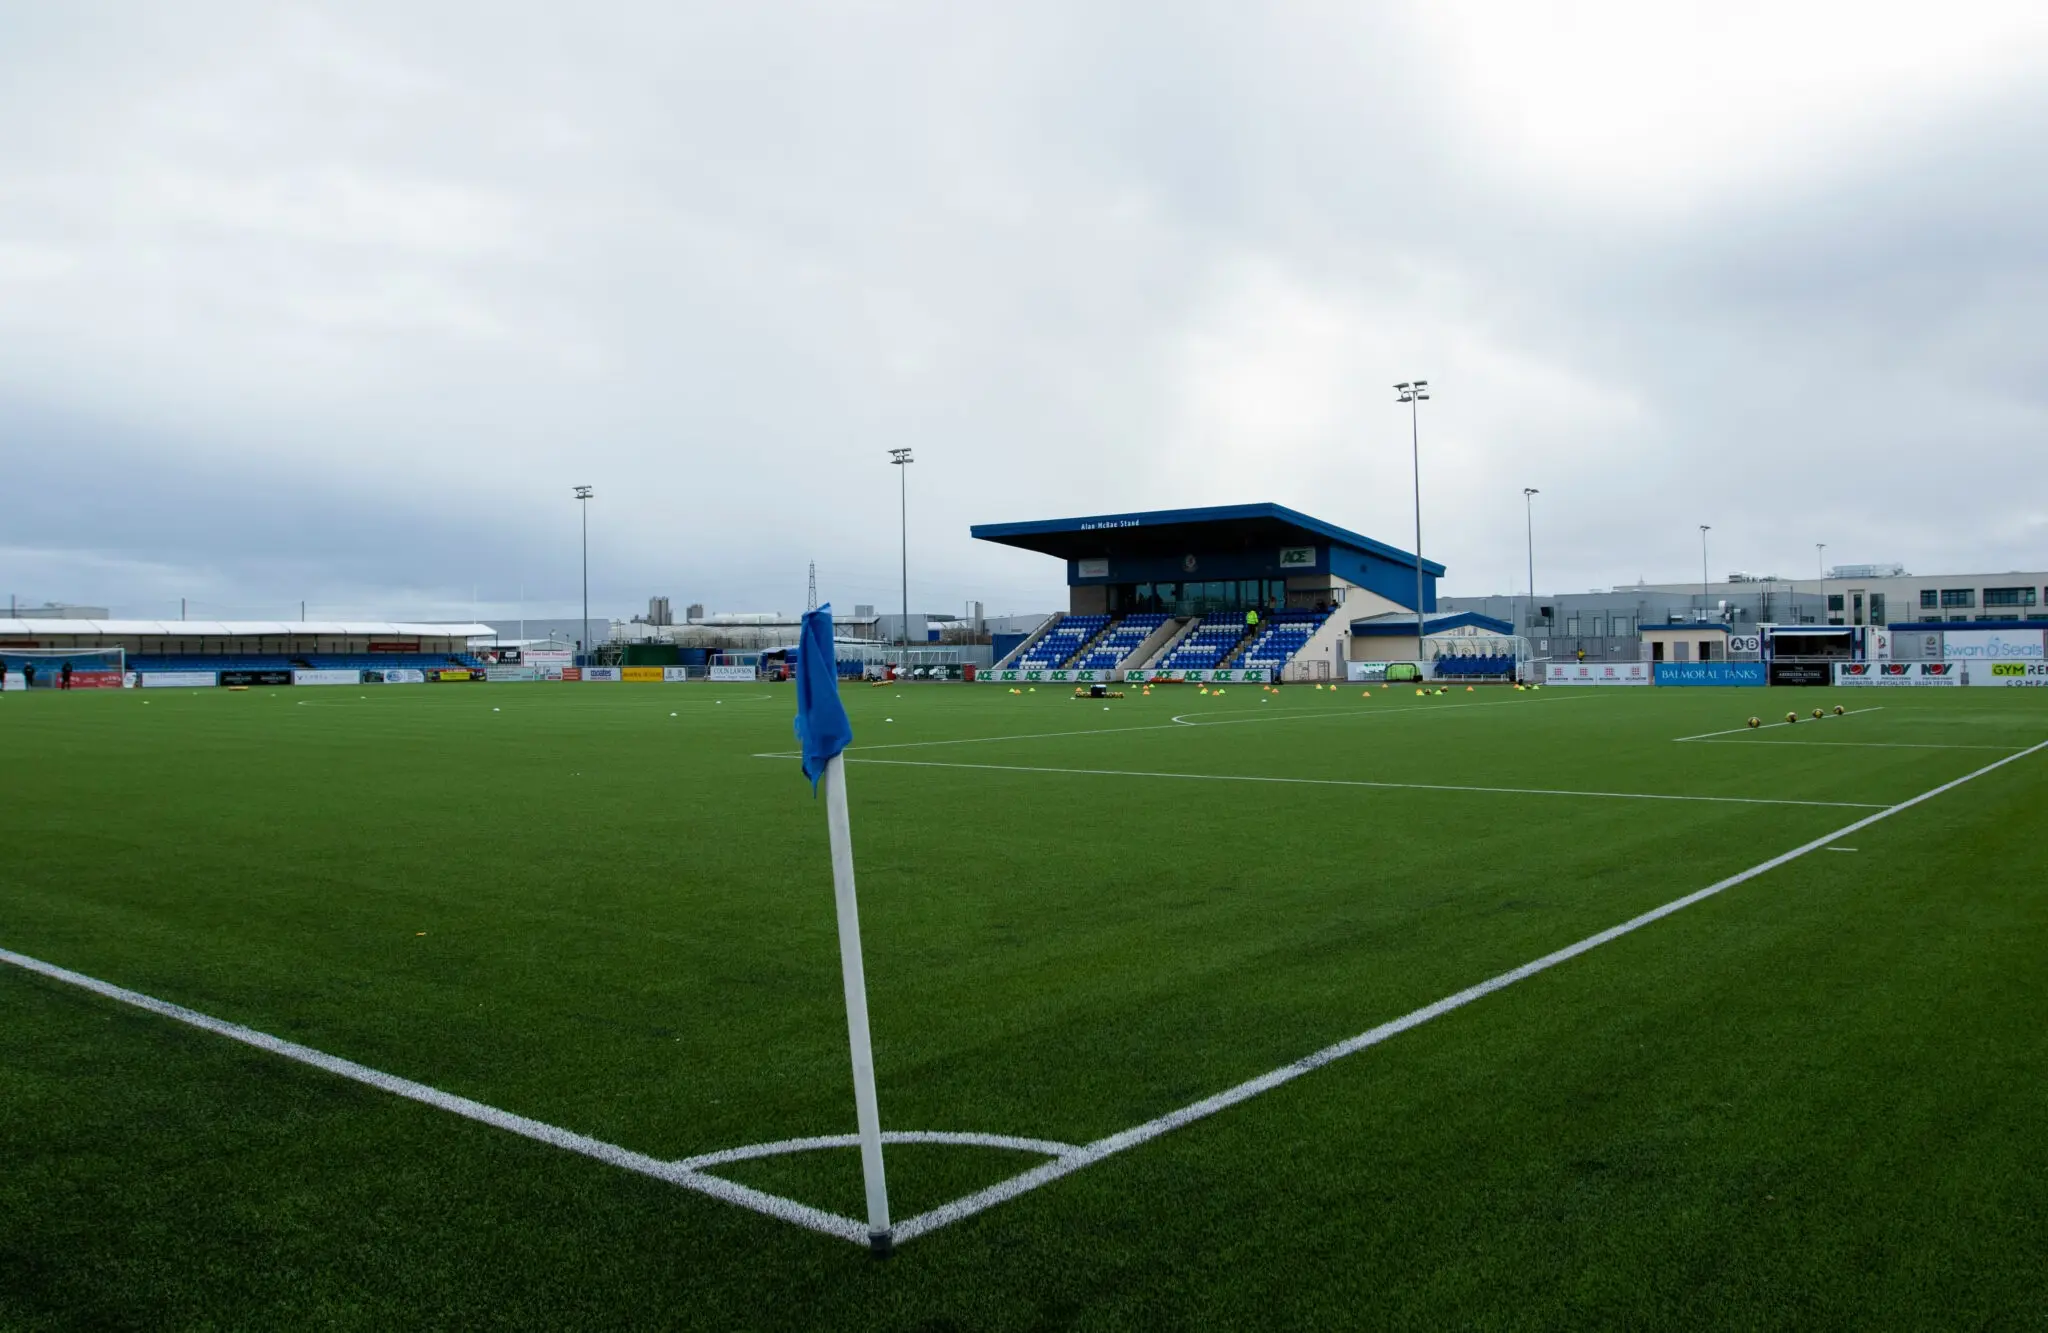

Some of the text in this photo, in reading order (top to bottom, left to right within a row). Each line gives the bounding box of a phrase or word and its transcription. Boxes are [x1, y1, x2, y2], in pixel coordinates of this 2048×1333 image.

[1097, 521, 1117, 529] McRae
[1120, 519, 1139, 527] Stand
[1282, 551, 1308, 564] ACE
[1944, 644, 1984, 656] Swan
[2002, 643, 2043, 656] Seals
[1662, 670, 1758, 680] BALMORAL TANKS
[1993, 665, 2048, 675] GYM RE
[976, 671, 1095, 680] ACE ACE ACE ACE ACE
[1126, 671, 1145, 681] ACE
[1184, 671, 1202, 681] ACE
[1211, 671, 1233, 681] ACE
[1242, 671, 1264, 681] ACE
